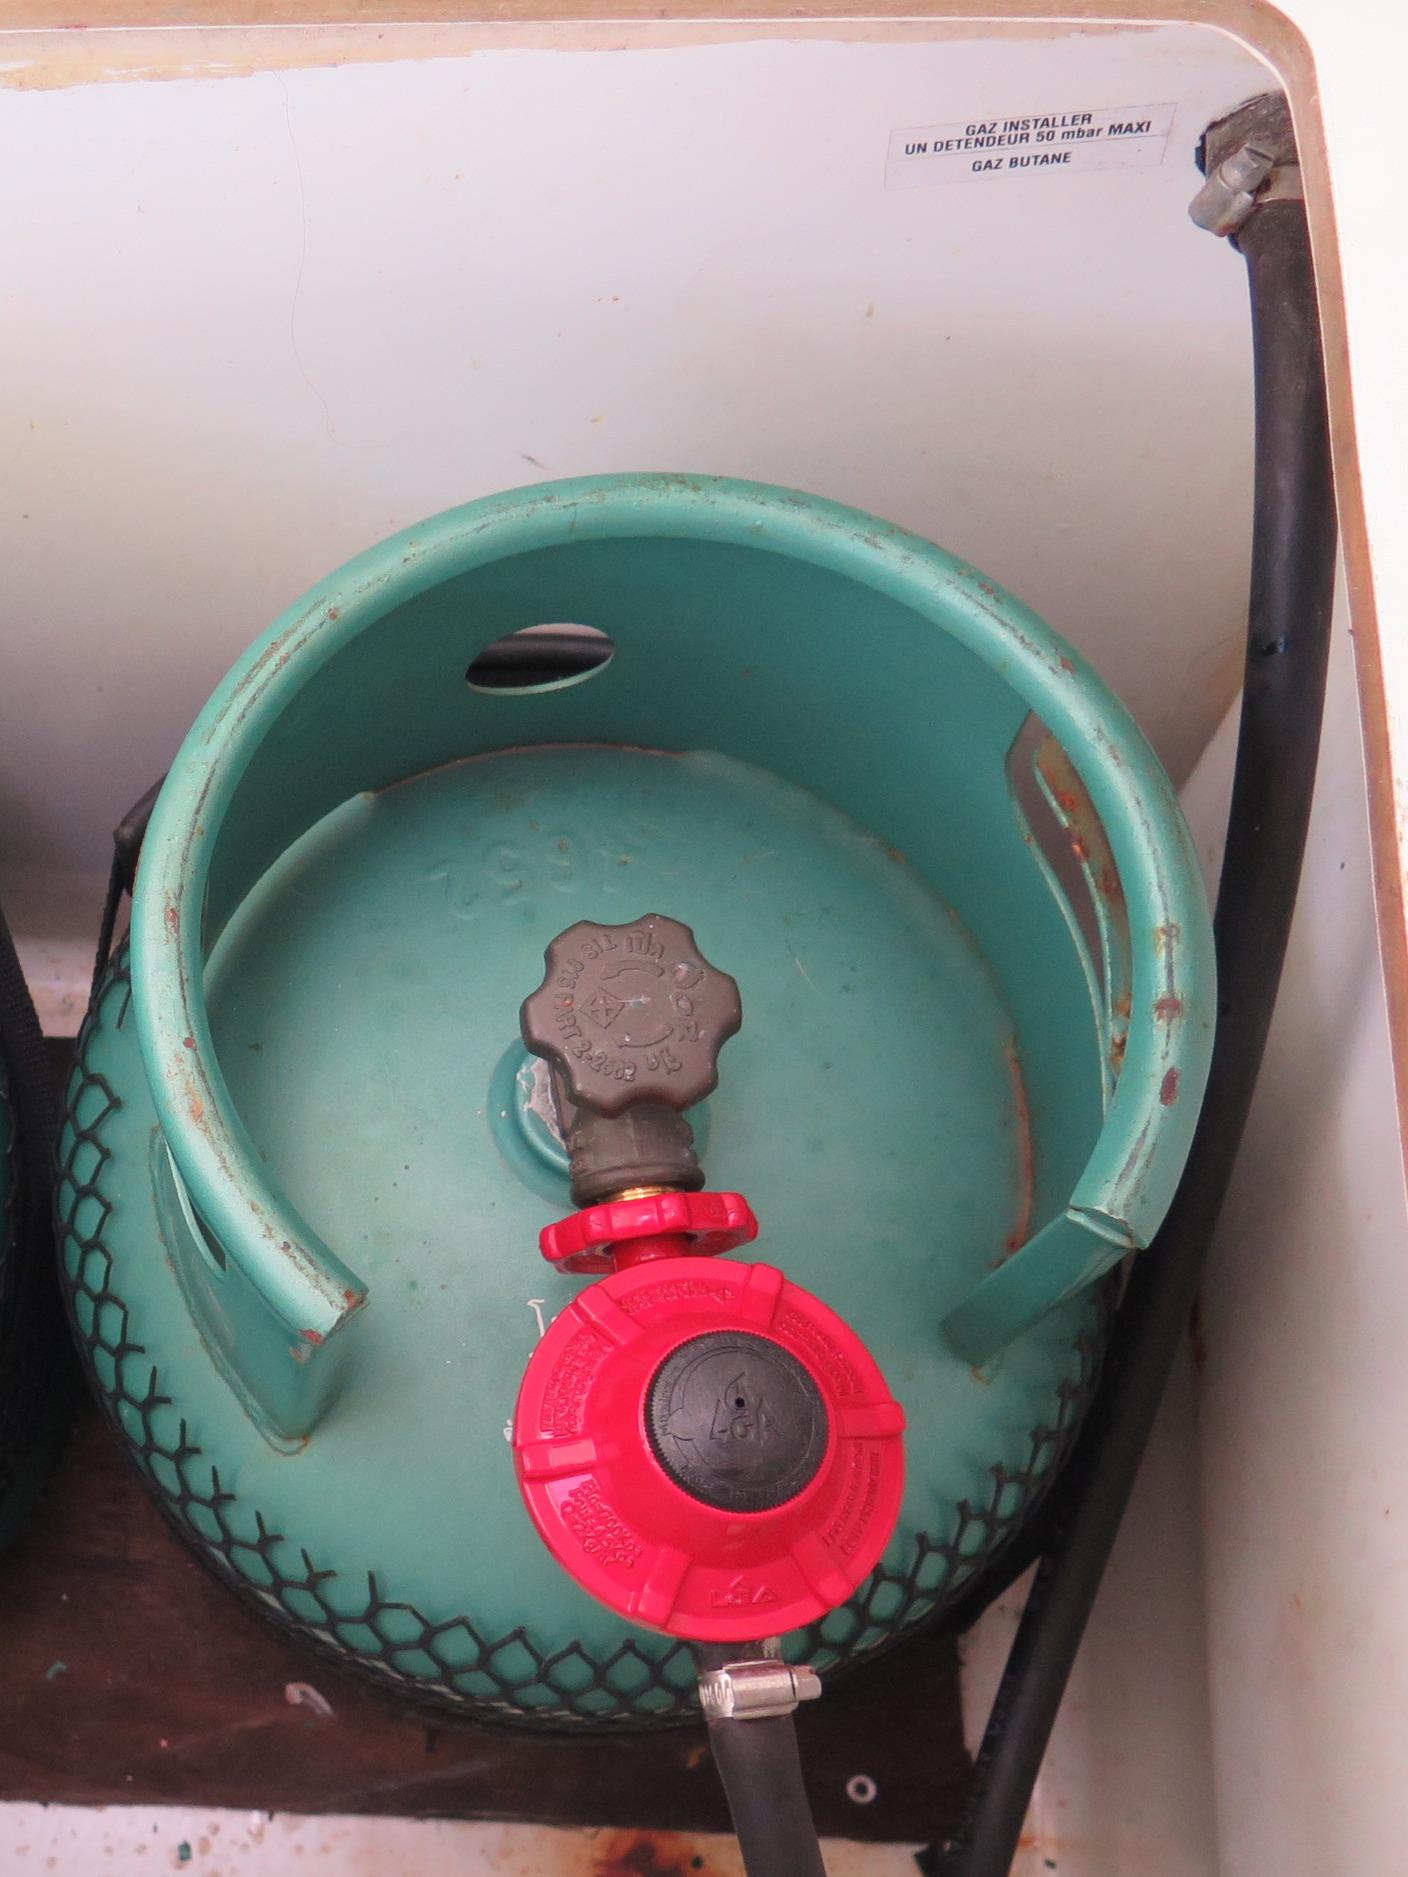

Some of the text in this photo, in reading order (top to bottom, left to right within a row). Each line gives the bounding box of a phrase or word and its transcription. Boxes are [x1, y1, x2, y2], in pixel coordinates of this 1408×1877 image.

[965, 113, 1092, 137] GAZ INSTALLER
[905, 121, 1151, 155] UN DETENDEUR 50 mbar MAXI
[972, 152, 1072, 172] GAZ BUTANE
